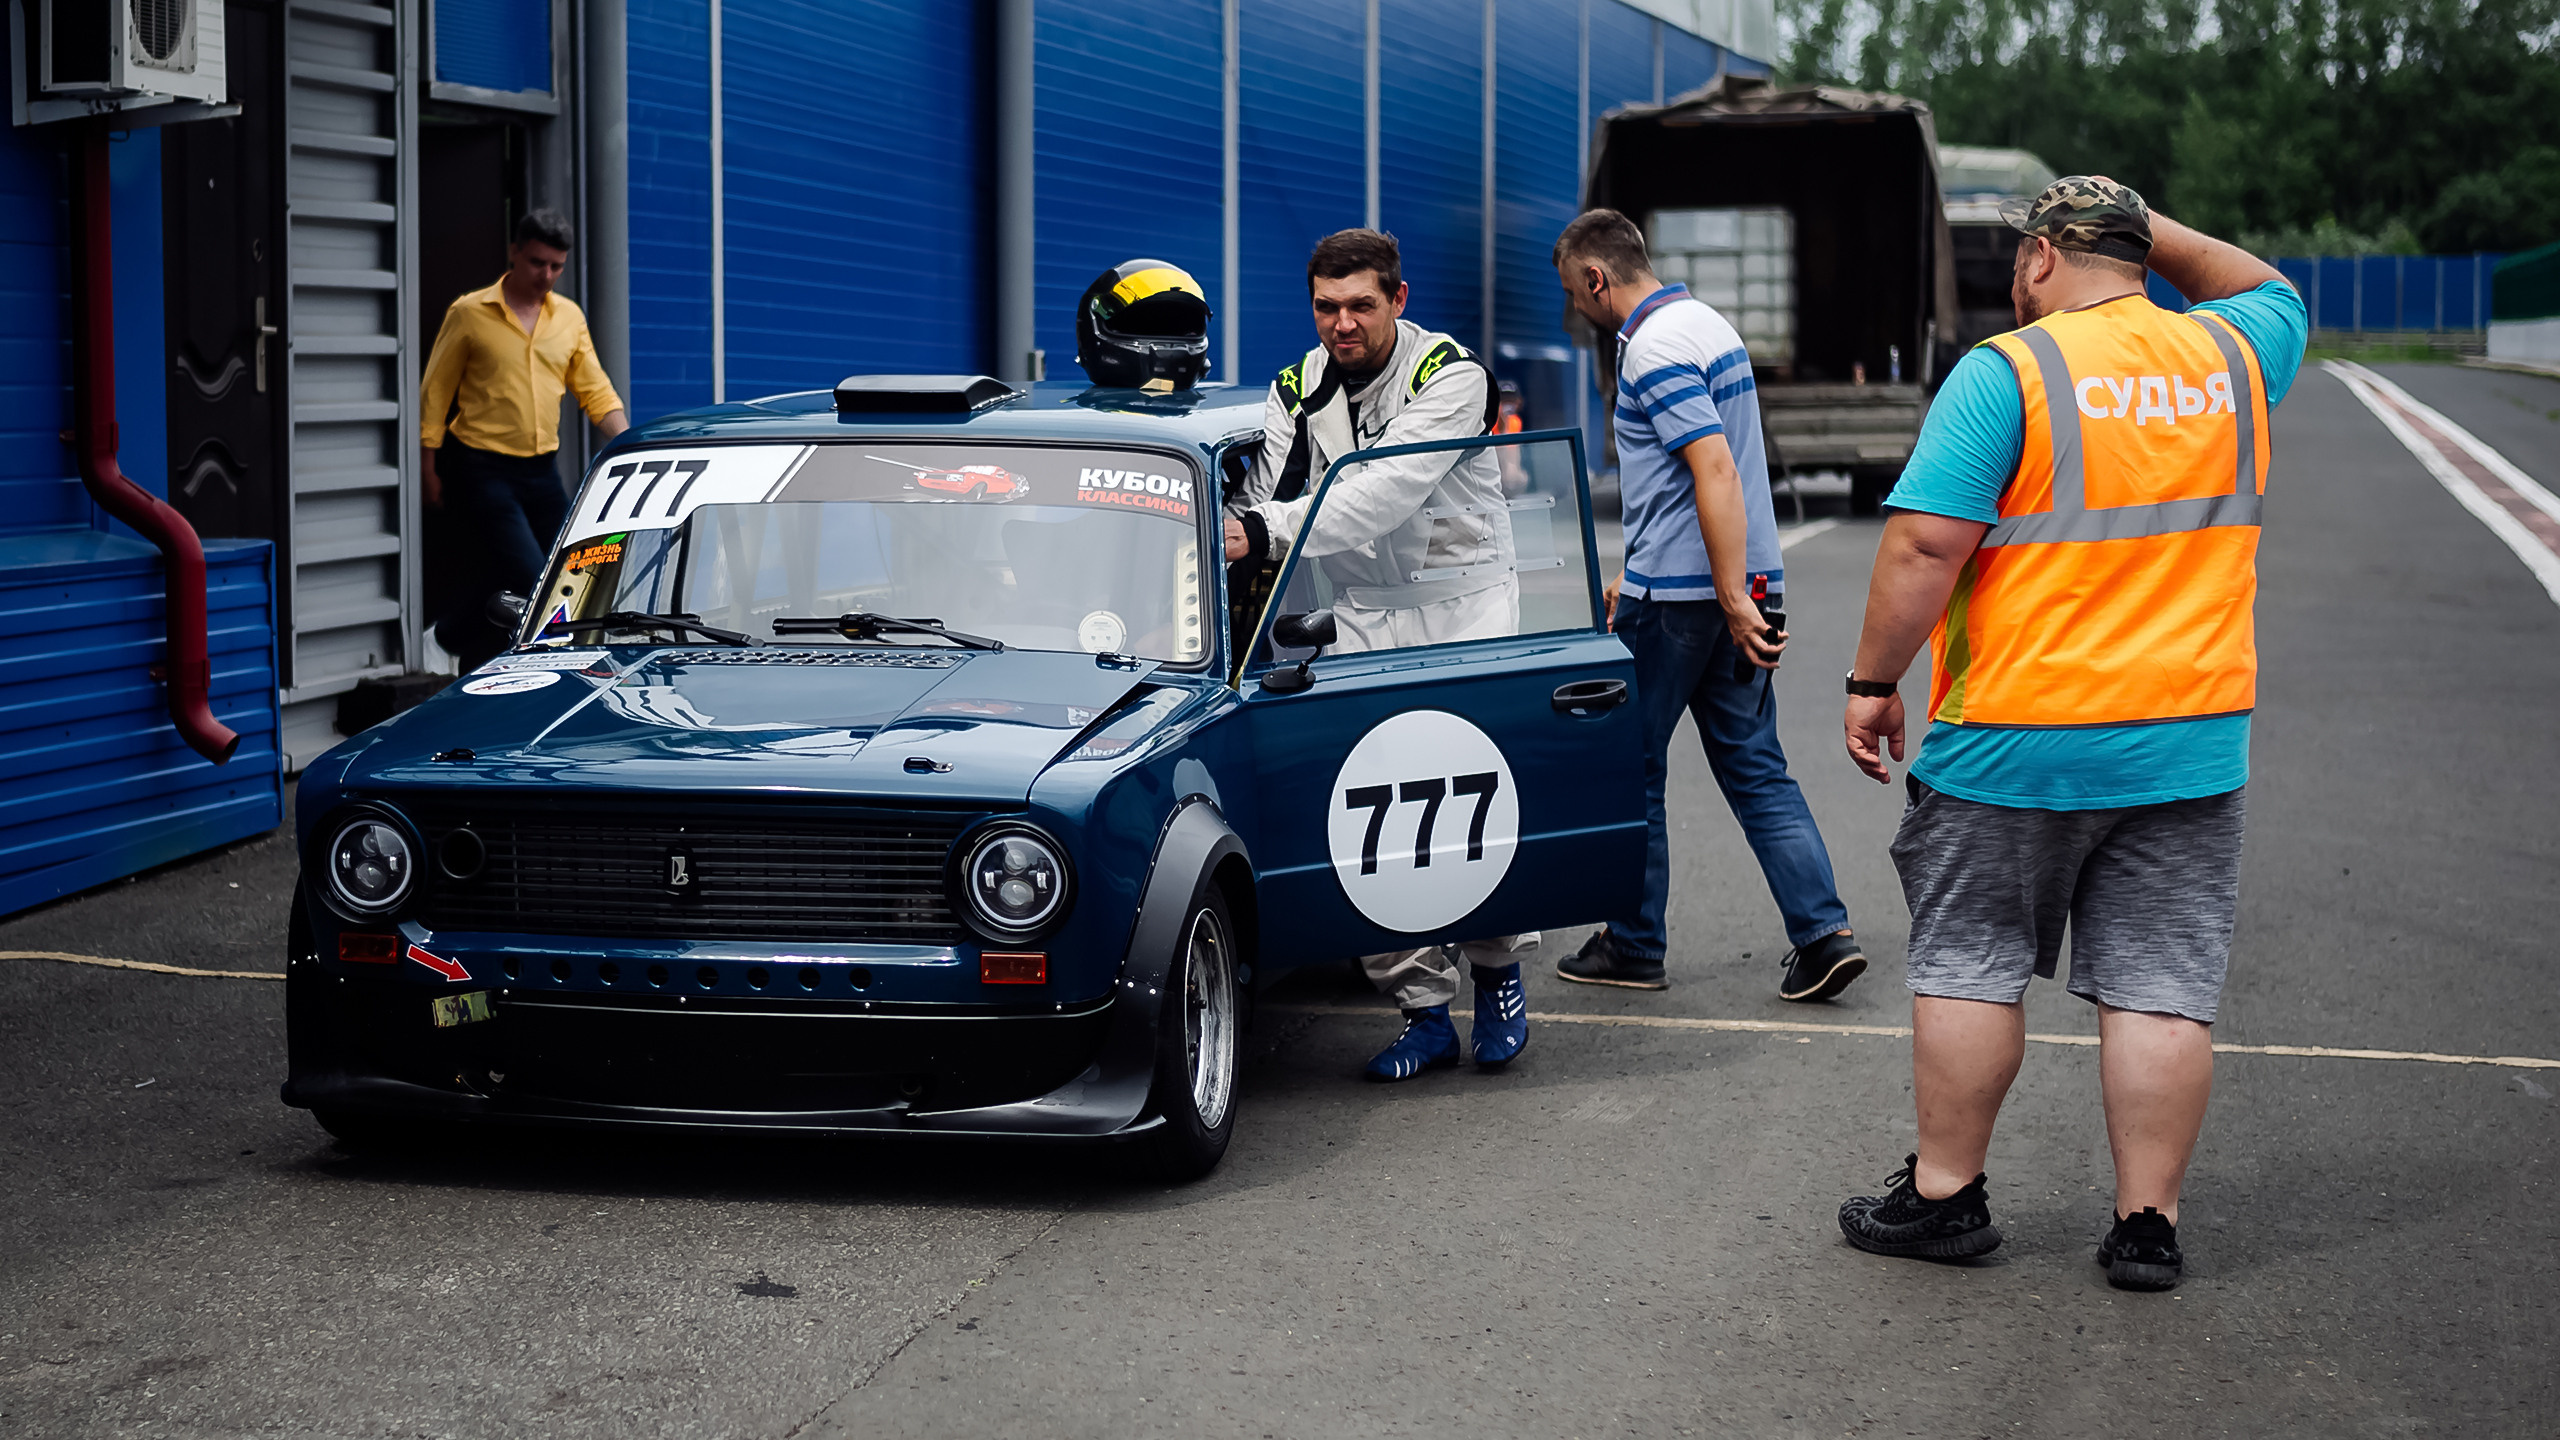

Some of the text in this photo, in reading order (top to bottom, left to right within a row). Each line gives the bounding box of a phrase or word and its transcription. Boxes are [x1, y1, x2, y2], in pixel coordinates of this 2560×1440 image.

[2074, 371, 2237, 426] СУДЬЯ
[595, 459, 711, 524] 777
[1078, 467, 1193, 502] КУБОК
[1077, 489, 1189, 517] КЛАССИКИ
[568, 543, 622, 563] ЗА ЖИЗНЬ
[577, 553, 620, 570] ДОРОГАХ
[1344, 770, 1499, 877] 777
